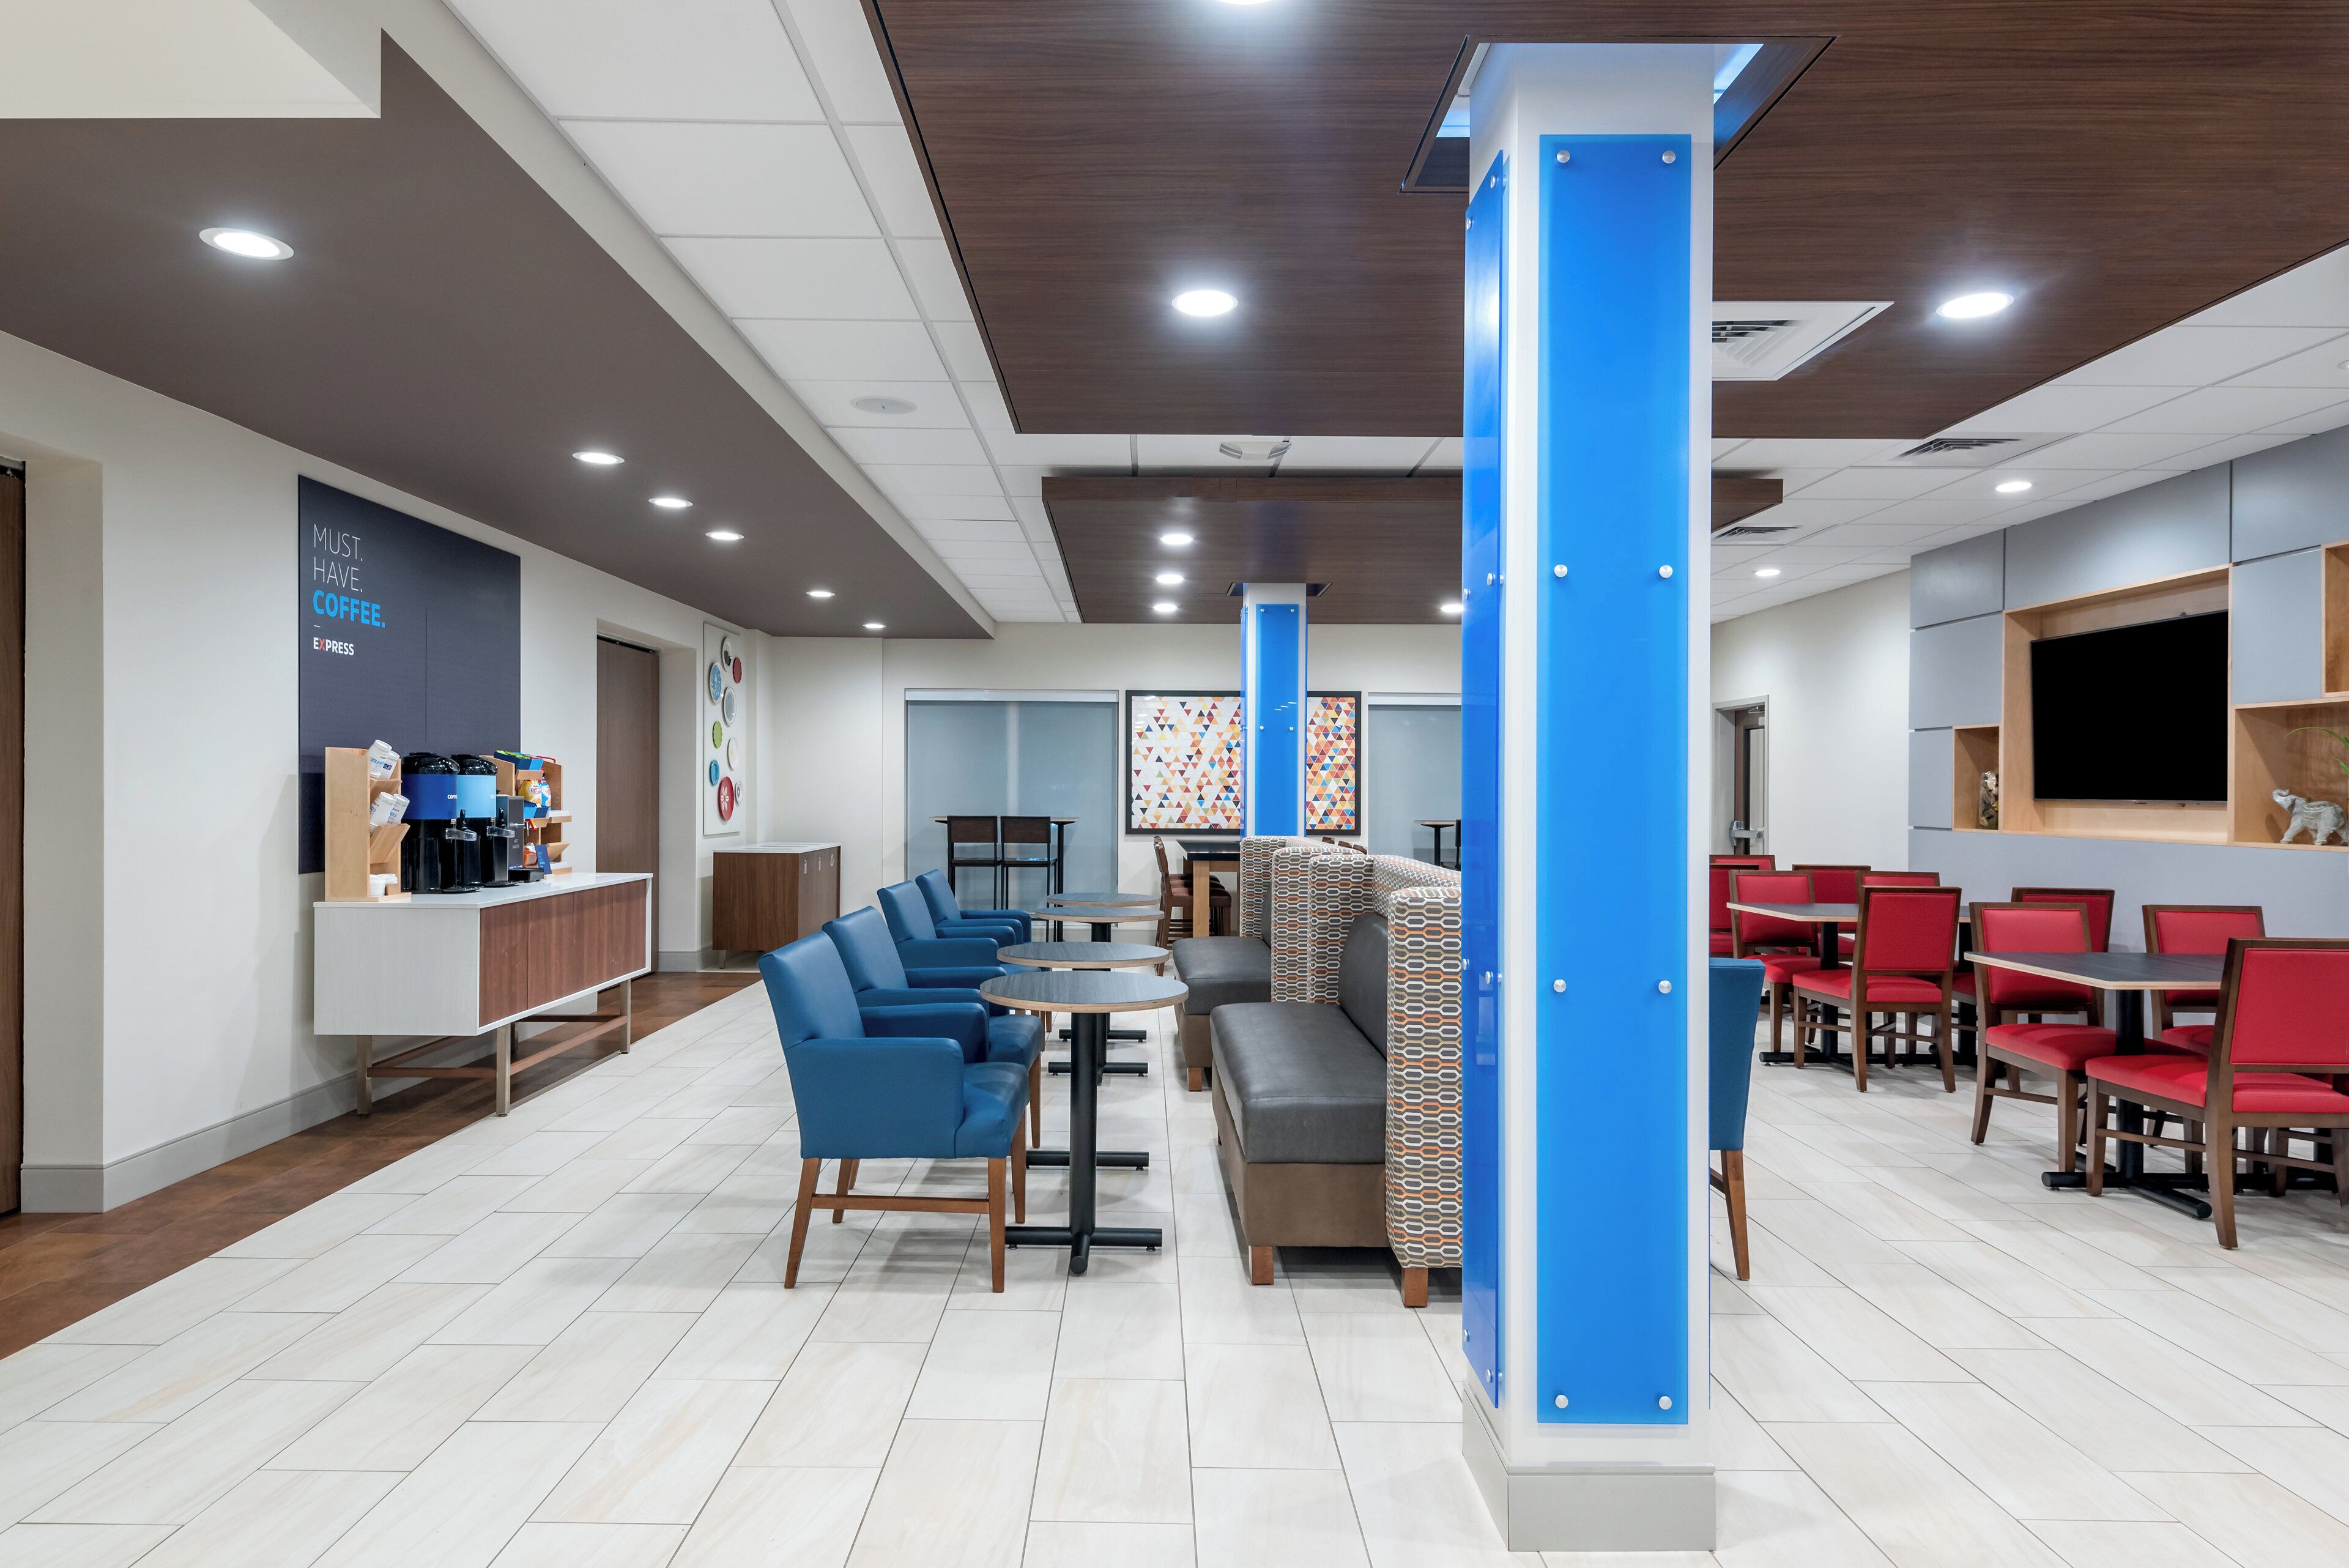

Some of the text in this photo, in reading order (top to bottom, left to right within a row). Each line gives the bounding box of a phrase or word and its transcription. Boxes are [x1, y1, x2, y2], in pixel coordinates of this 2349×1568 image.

[314, 524, 363, 562] MUST.
[314, 557, 363, 592] HAVE.
[313, 589, 385, 628] COFFEE.
[313, 637, 354, 656] EXPRESS
